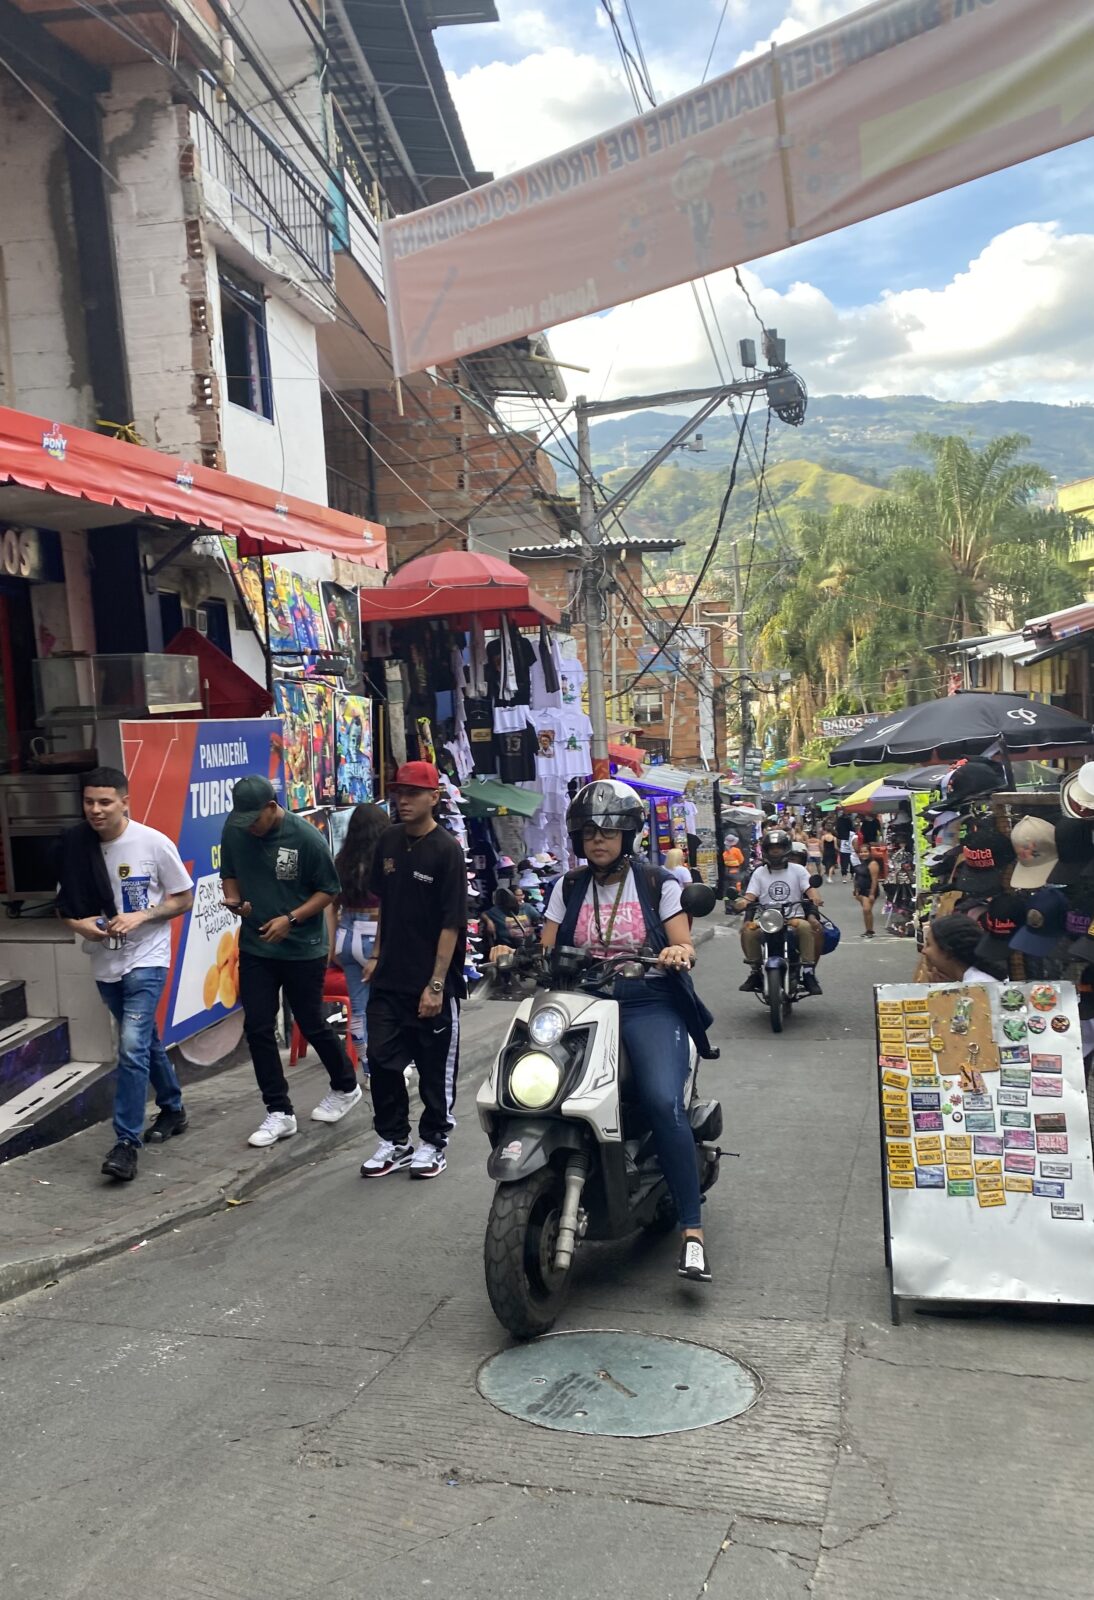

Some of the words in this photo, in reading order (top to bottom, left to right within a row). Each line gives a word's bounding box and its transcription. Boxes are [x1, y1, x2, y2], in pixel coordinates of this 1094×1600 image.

[43, 438, 67, 449] PONY
[0, 529, 31, 576] OS
[823, 715, 863, 730] BAÑOS
[200, 736, 249, 769] PANADERÍA
[190, 777, 243, 819] TURIS
